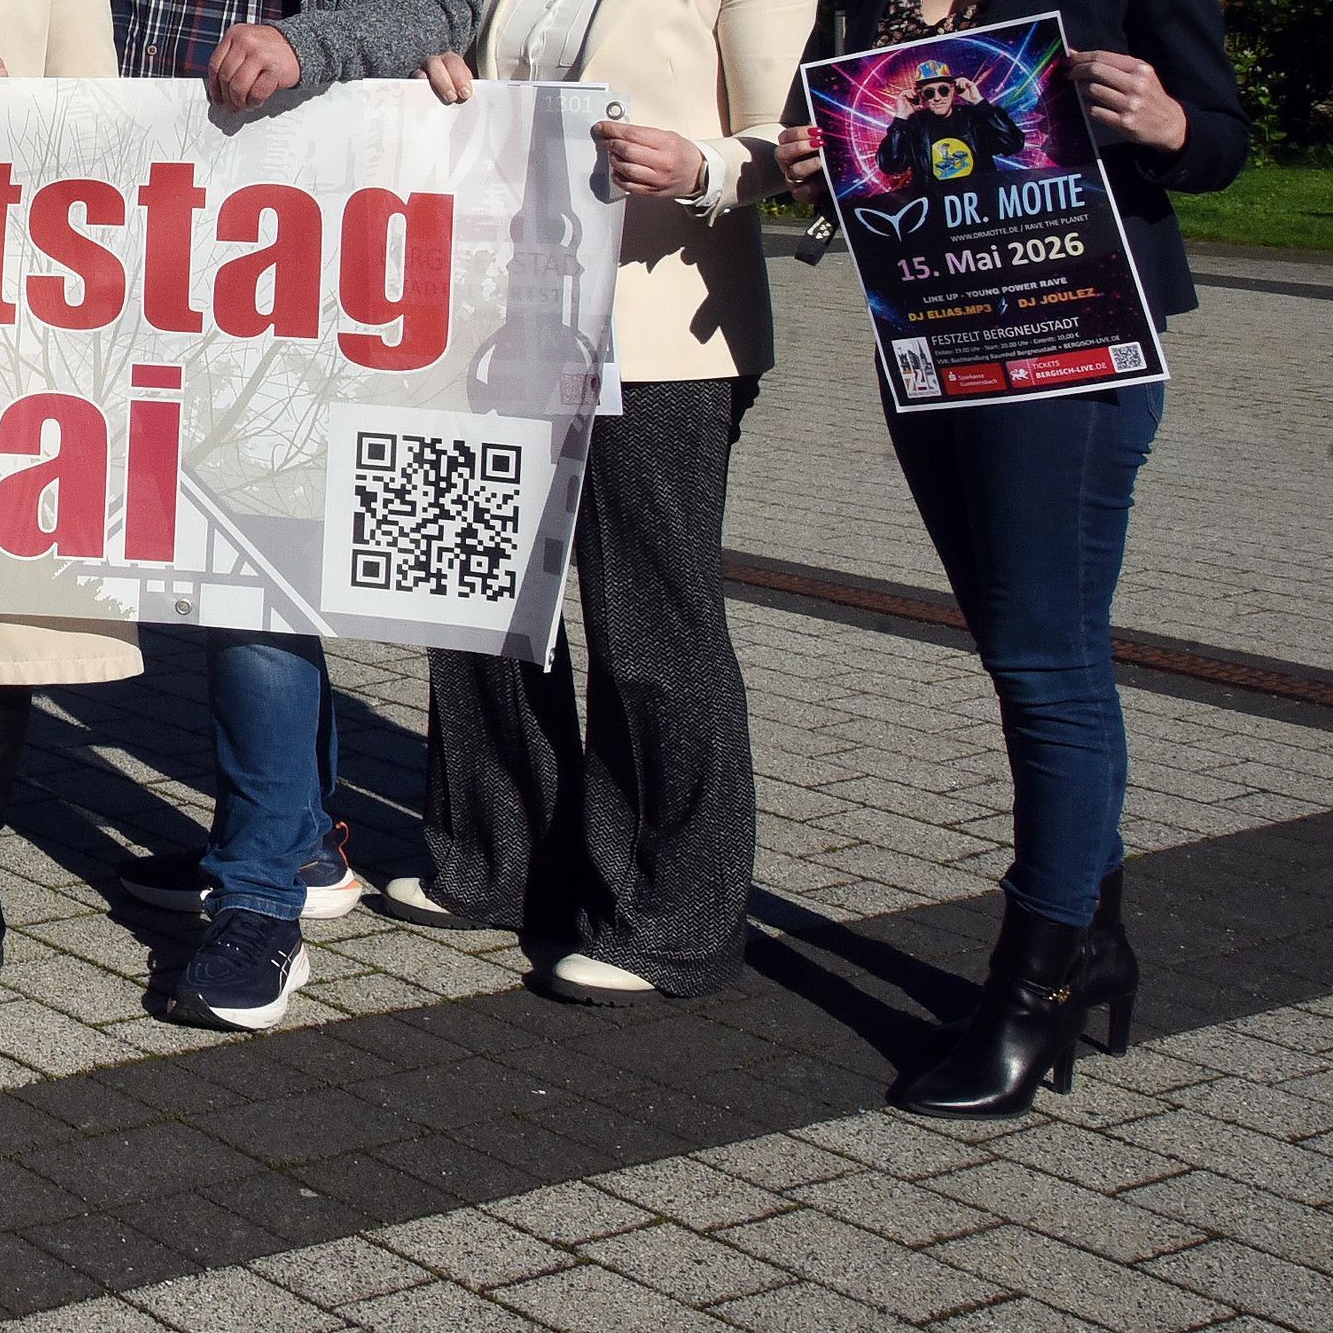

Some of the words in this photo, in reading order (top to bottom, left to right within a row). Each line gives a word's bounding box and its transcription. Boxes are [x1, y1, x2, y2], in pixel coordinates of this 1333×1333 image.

[943, 192, 989, 228] DR.
[998, 173, 1085, 220] MOTTE
[950, 226, 1019, 242] WWW.DRMOTTE.DE
[1024, 222, 1044, 232] RAVE
[1045, 219, 1060, 228] THE
[1061, 214, 1089, 225] PLANET
[897, 256, 939, 282] 15.
[945, 244, 1002, 275] Mai
[1007, 232, 1084, 266] 2026
[923, 294, 945, 304] LINE
[946, 293, 959, 302] UP
[966, 288, 1000, 299] YOUNG
[1002, 282, 1038, 294] POWER
[1040, 277, 1068, 288] RAVE
[1017, 296, 1036, 308] DJ
[1039, 288, 1096, 305] JOULEZ
[908, 312, 924, 322] DJ
[927, 304, 993, 320] ELIAS.MP3
[931, 330, 980, 346] FESTZELT
[983, 316, 1080, 341] BERGNEUSTADT
[1017, 346, 1057, 356] Bergneustadt
[1033, 360, 1061, 369] TICKETS
[1035, 362, 1107, 379] BERGISCH-LIVE.DE
